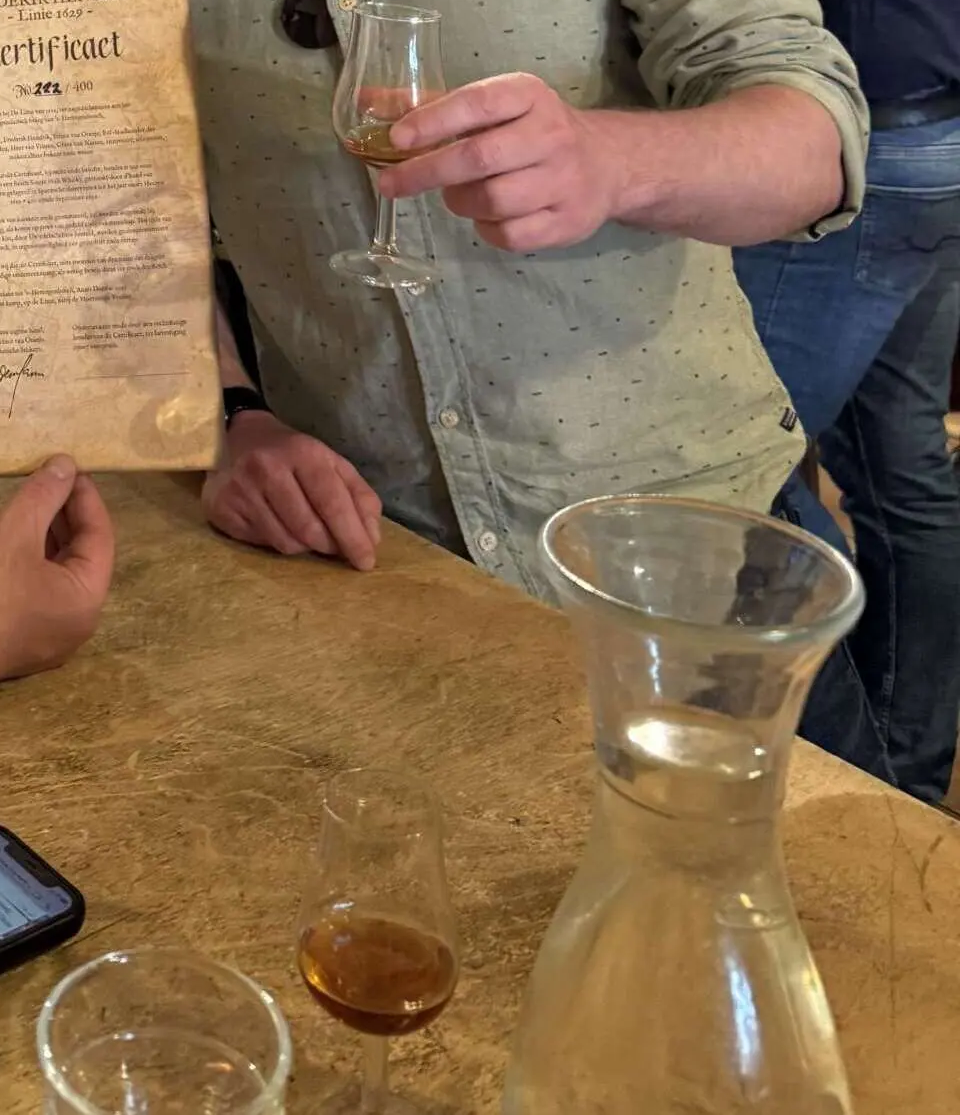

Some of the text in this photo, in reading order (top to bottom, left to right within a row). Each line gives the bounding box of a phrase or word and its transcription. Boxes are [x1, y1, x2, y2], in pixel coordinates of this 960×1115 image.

[17, 9, 53, 22] Linie
[57, 8, 83, 20] 1629
[32, 81, 62, 96] 222
[72, 81, 93, 92] 400
